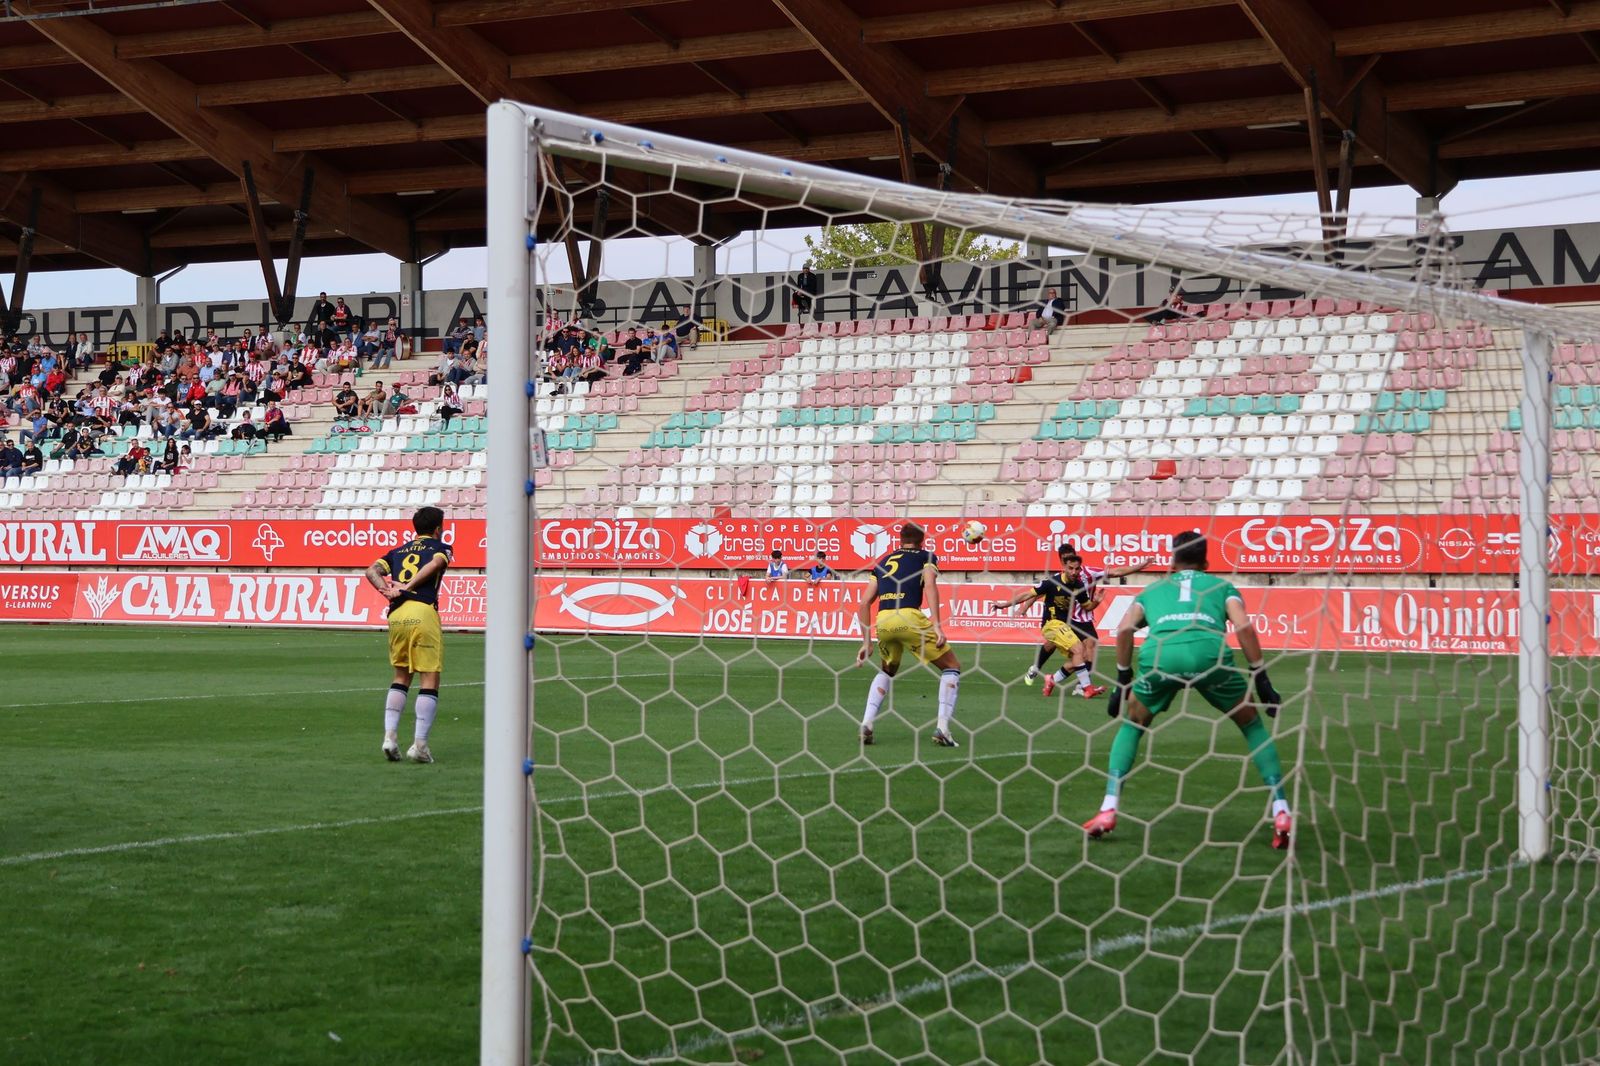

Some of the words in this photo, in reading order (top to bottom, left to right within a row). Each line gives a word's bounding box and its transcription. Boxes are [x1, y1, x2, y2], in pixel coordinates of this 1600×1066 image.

[122, 526, 220, 559] AMAQ
[304, 523, 397, 547] recoletas
[723, 535, 765, 552] tres
[771, 537, 840, 552] cruces
[943, 537, 1016, 552] cruces
[1036, 539, 1049, 551] la
[542, 552, 600, 560] EMBUTIDOS
[612, 552, 661, 560] JAMONES
[1103, 553, 1126, 566] de
[1240, 554, 1319, 563] EMBUTIDOS
[1335, 555, 1401, 563] JAMONES
[399, 553, 420, 583] 8
[881, 553, 904, 579] 5
[1, 585, 60, 599] VERSUS
[121, 575, 215, 619] CAJA
[224, 575, 369, 622] RURAL
[793, 586, 862, 603] DENTAL
[1178, 578, 1192, 602] 1
[703, 602, 752, 632] JOSÉ
[760, 610, 788, 633] DE
[796, 611, 862, 635] PAULA
[1342, 591, 1382, 635] La
[992, 621, 1035, 629] COMERCIAL
[1354, 636, 1367, 647] El
[1370, 637, 1417, 648] Correo
[1431, 637, 1448, 649] de
[1450, 637, 1505, 649] Zamora
